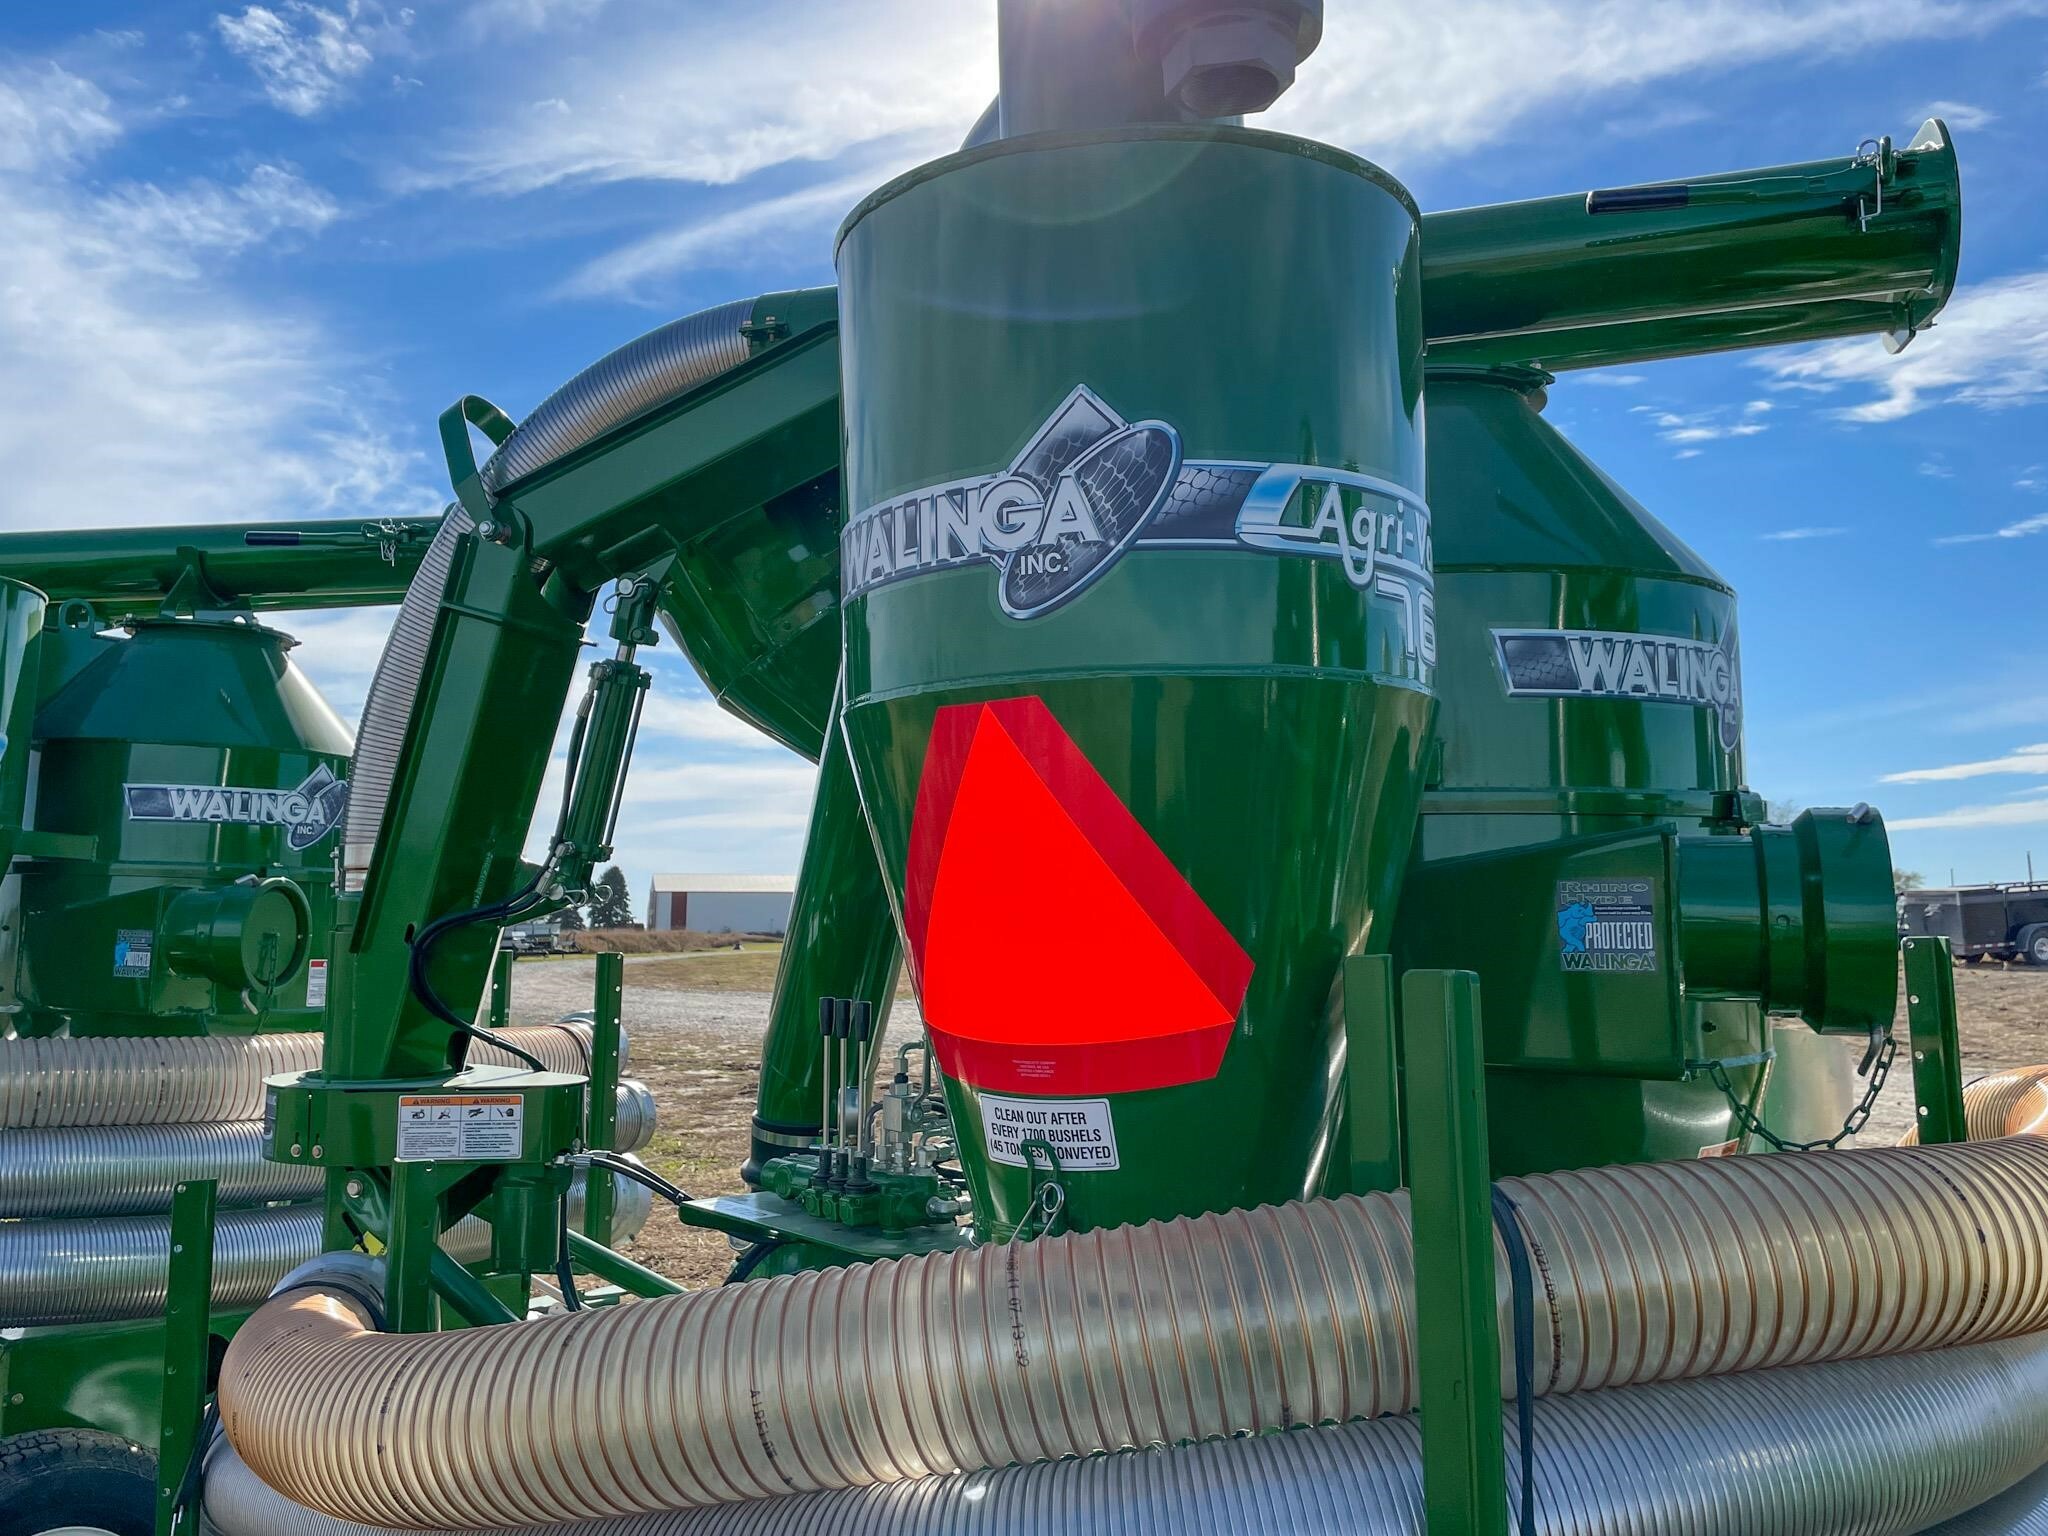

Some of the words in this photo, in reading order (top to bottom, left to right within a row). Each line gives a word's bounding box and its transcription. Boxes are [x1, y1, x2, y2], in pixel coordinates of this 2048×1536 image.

[843, 470, 1104, 594] WALINGA
[1019, 550, 1069, 577] INC.
[1567, 637, 1739, 706] WALINGA
[169, 789, 327, 826] WALINGA
[297, 825, 315, 836] INC.
[1585, 922, 1653, 949] PROTECTED
[994, 1107, 1024, 1123] CLEAN
[1026, 1111, 1047, 1125] OUT
[1051, 1112, 1087, 1125] AFTER
[991, 1123, 1019, 1139] EVERY
[1022, 1128, 1046, 1141] 1700
[1050, 1129, 1102, 1143] BUSHELS
[990, 1138, 1003, 1154] (45
[1005, 1141, 1047, 1161] TONES)
[1056, 1146, 1111, 1160] ONVEYED
